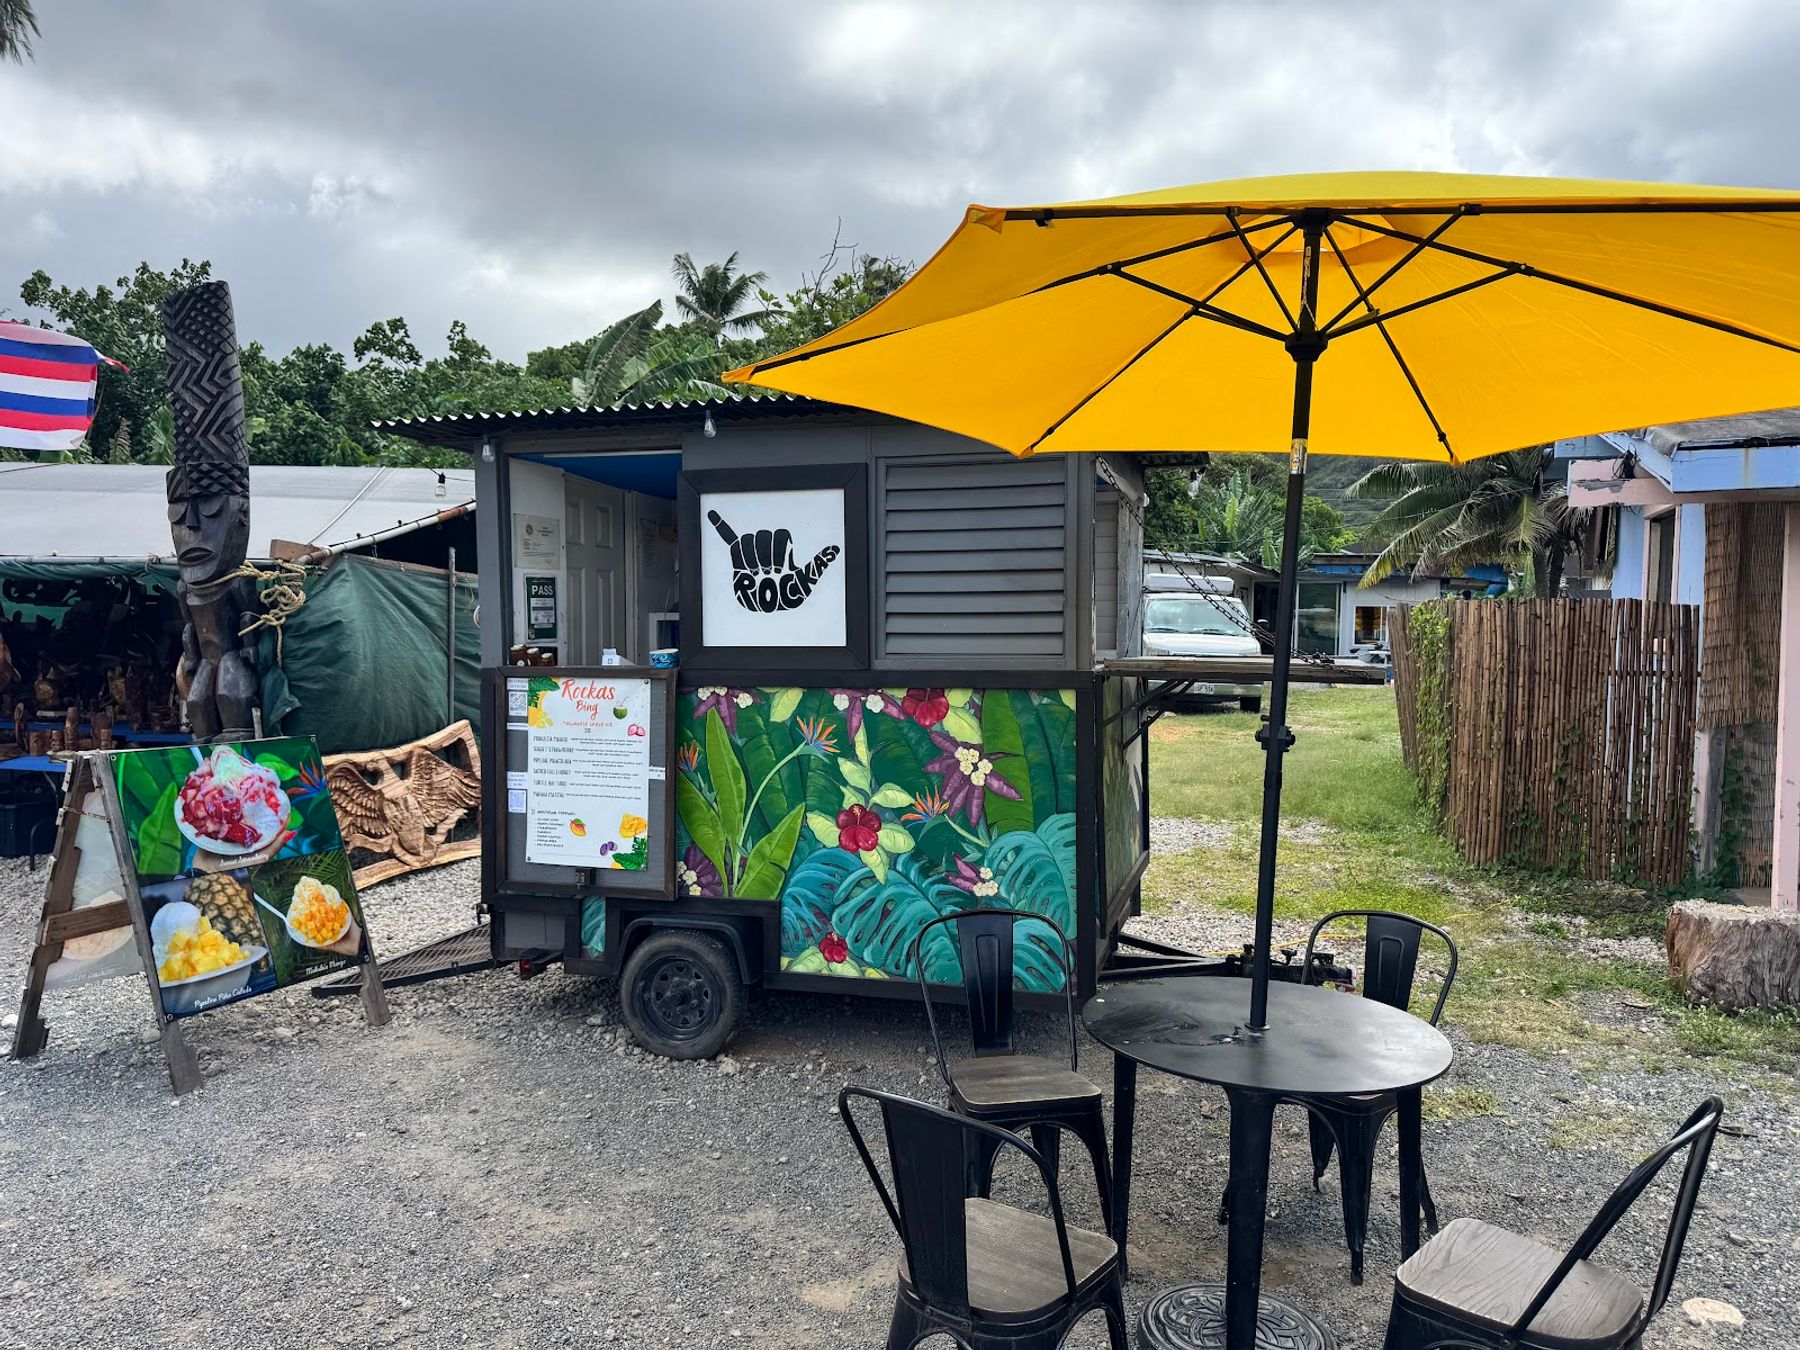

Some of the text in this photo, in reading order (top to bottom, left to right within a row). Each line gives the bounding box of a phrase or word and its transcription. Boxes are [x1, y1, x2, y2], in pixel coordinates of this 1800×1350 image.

[531, 584, 554, 596] PASS
[732, 544, 841, 614] ROCKAS
[561, 678, 615, 701] Rockas
[575, 699, 599, 721] Bing
